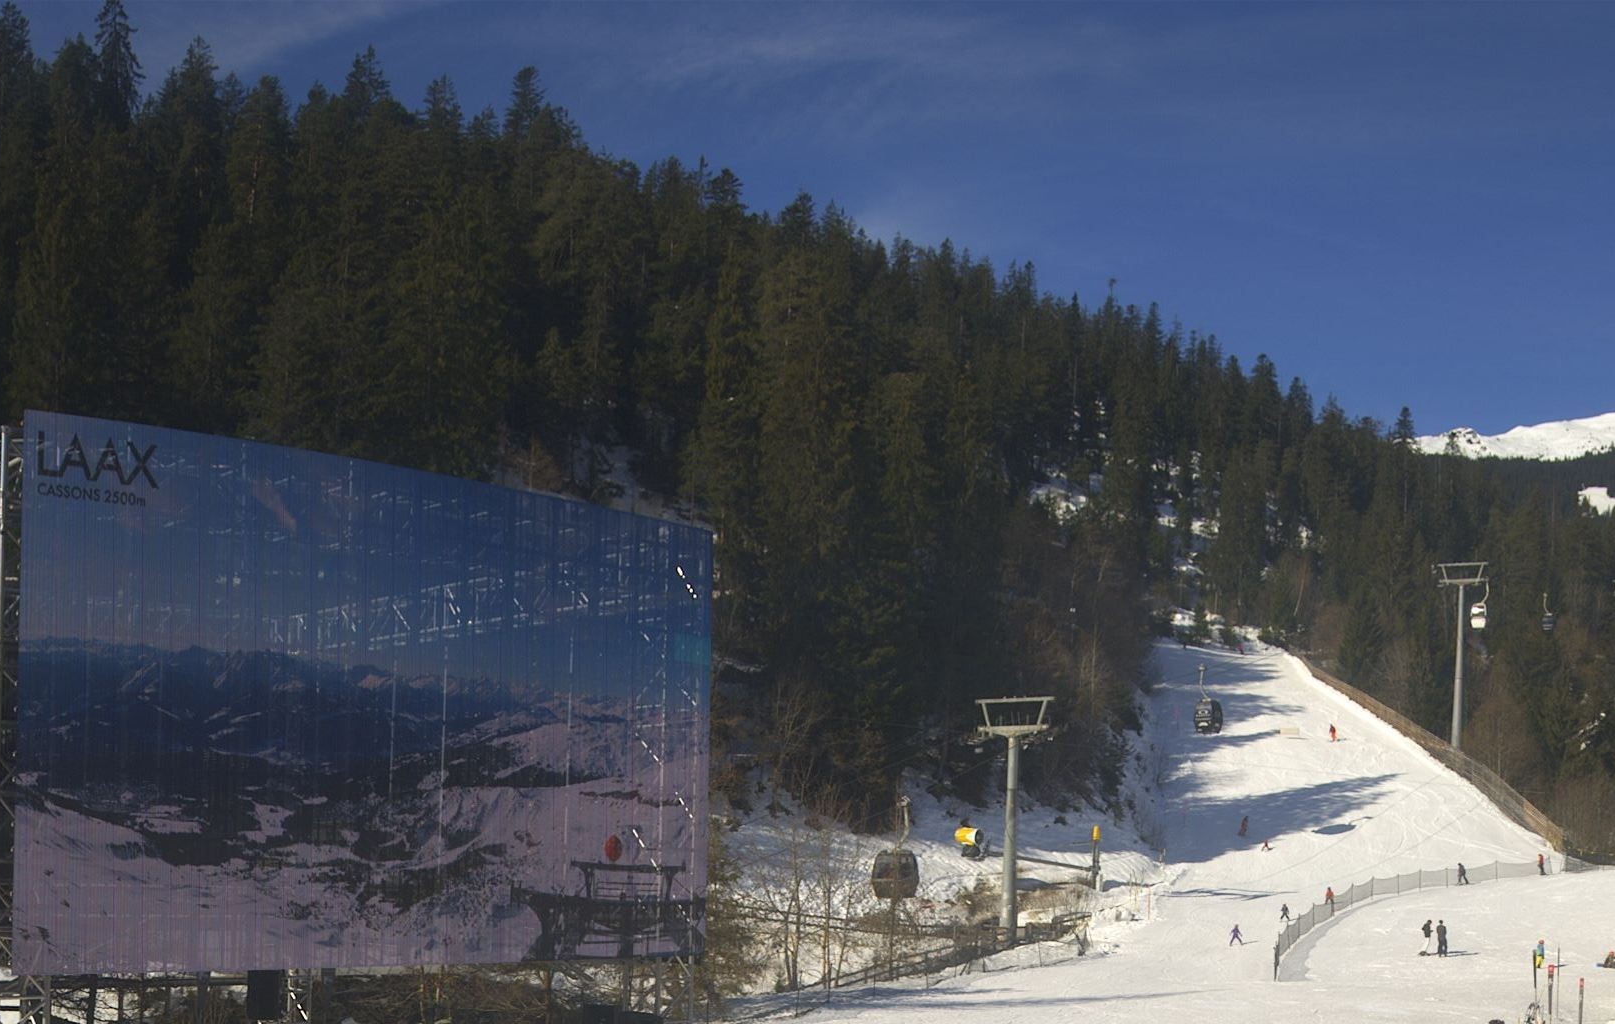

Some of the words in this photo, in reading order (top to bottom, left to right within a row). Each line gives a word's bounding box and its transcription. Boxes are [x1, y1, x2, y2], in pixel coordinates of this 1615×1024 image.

[37, 431, 159, 490] LAAX
[37, 483, 101, 501] CASSONS
[104, 491, 146, 507] 2500m
